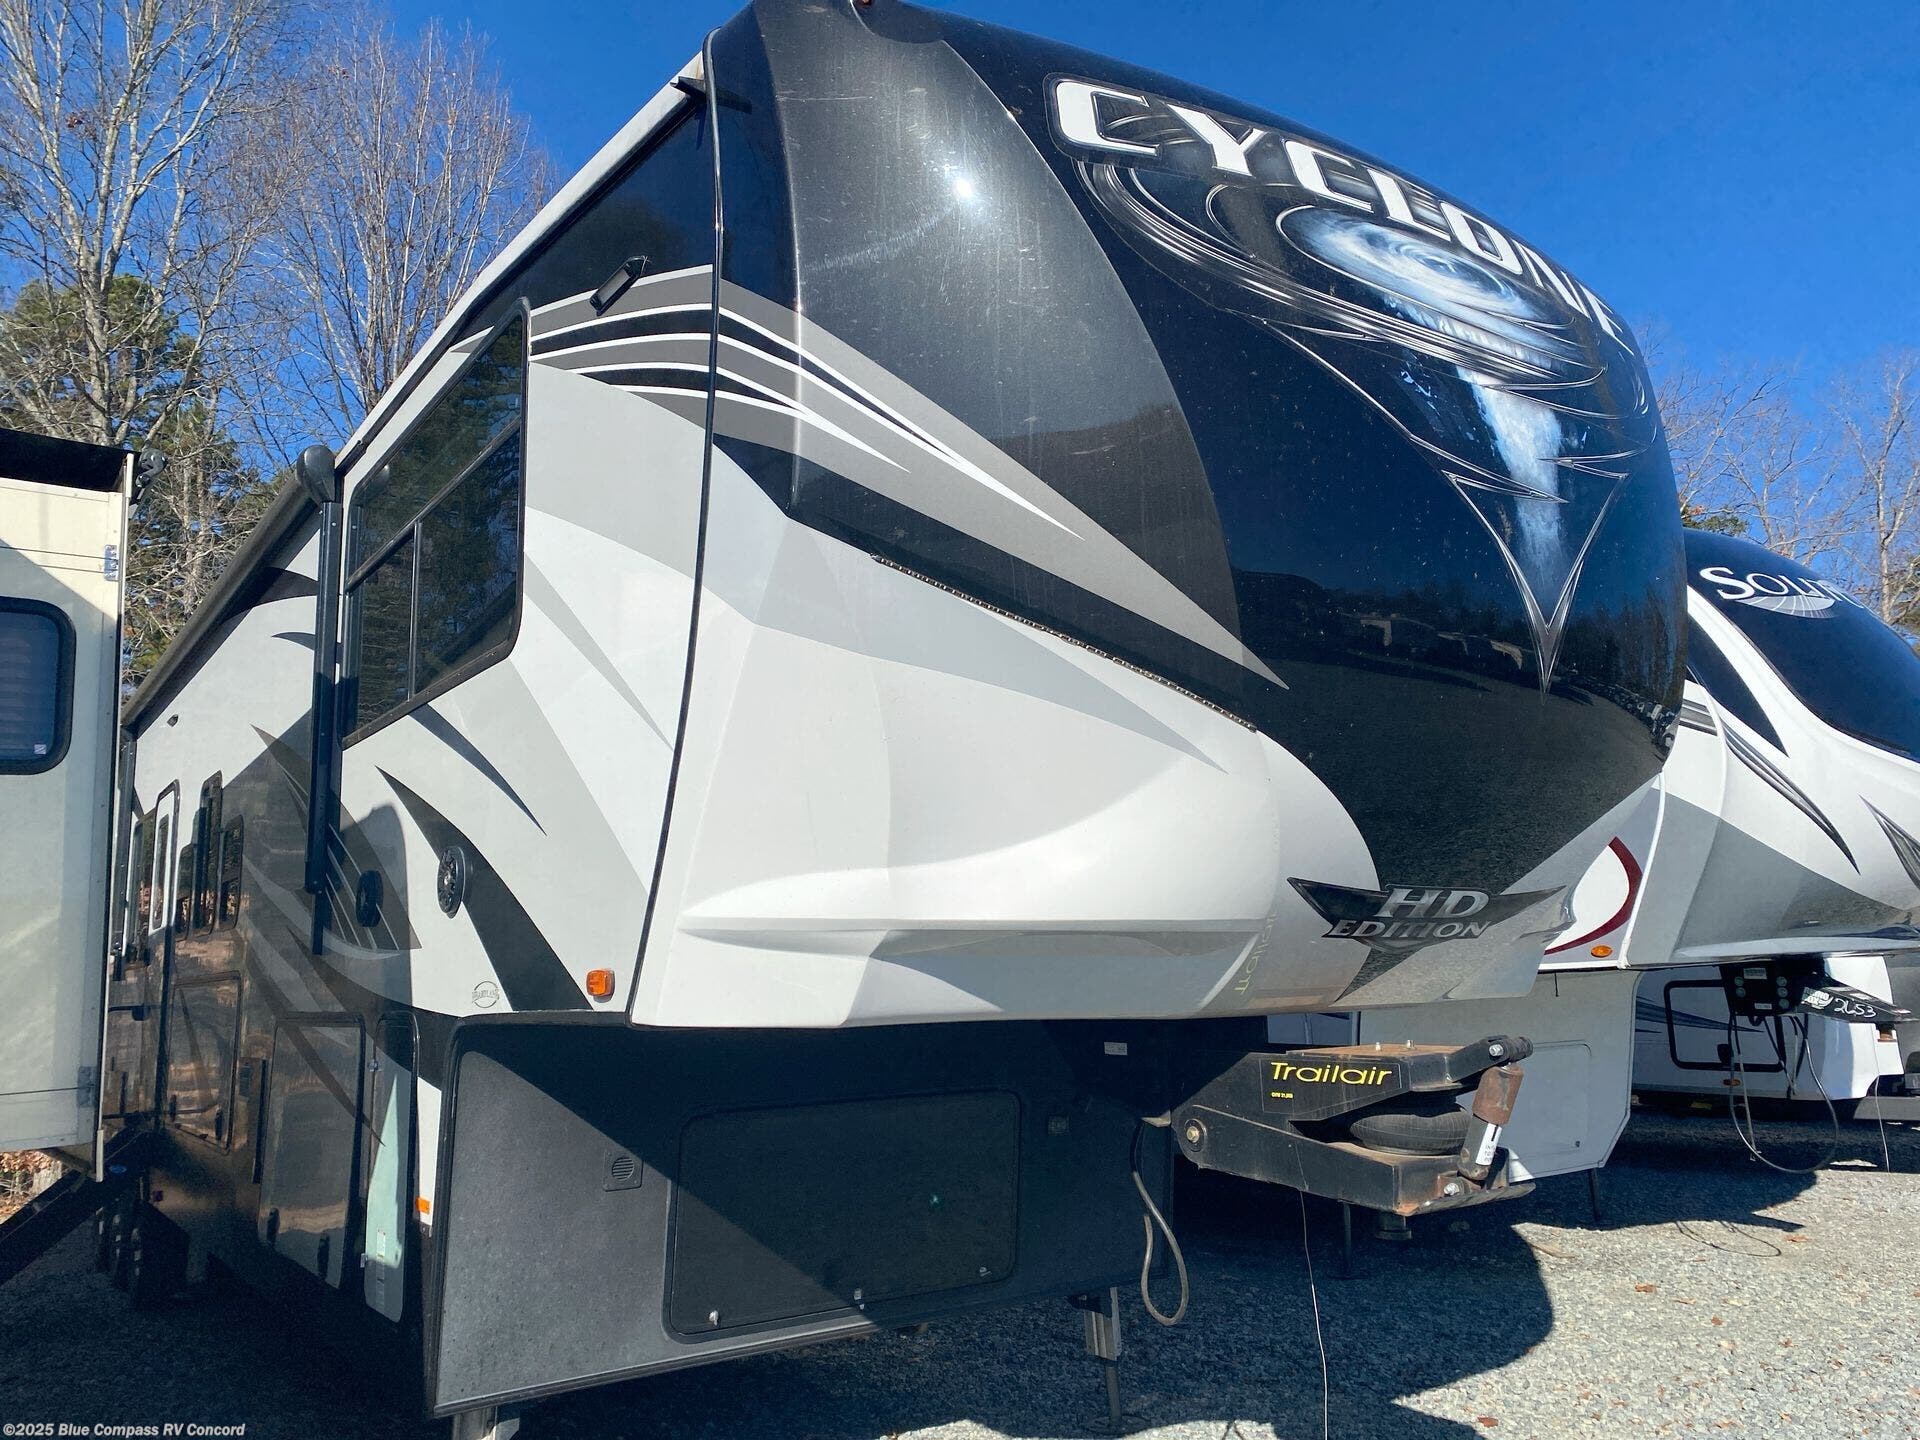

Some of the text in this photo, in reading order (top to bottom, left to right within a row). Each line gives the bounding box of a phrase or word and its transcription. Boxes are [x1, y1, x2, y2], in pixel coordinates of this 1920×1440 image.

[1055, 80, 1635, 357] CYCLONE
[1373, 888, 1490, 919] HD
[1327, 919, 1492, 939] EDITION
[1270, 1062, 1393, 1086] Trailair
